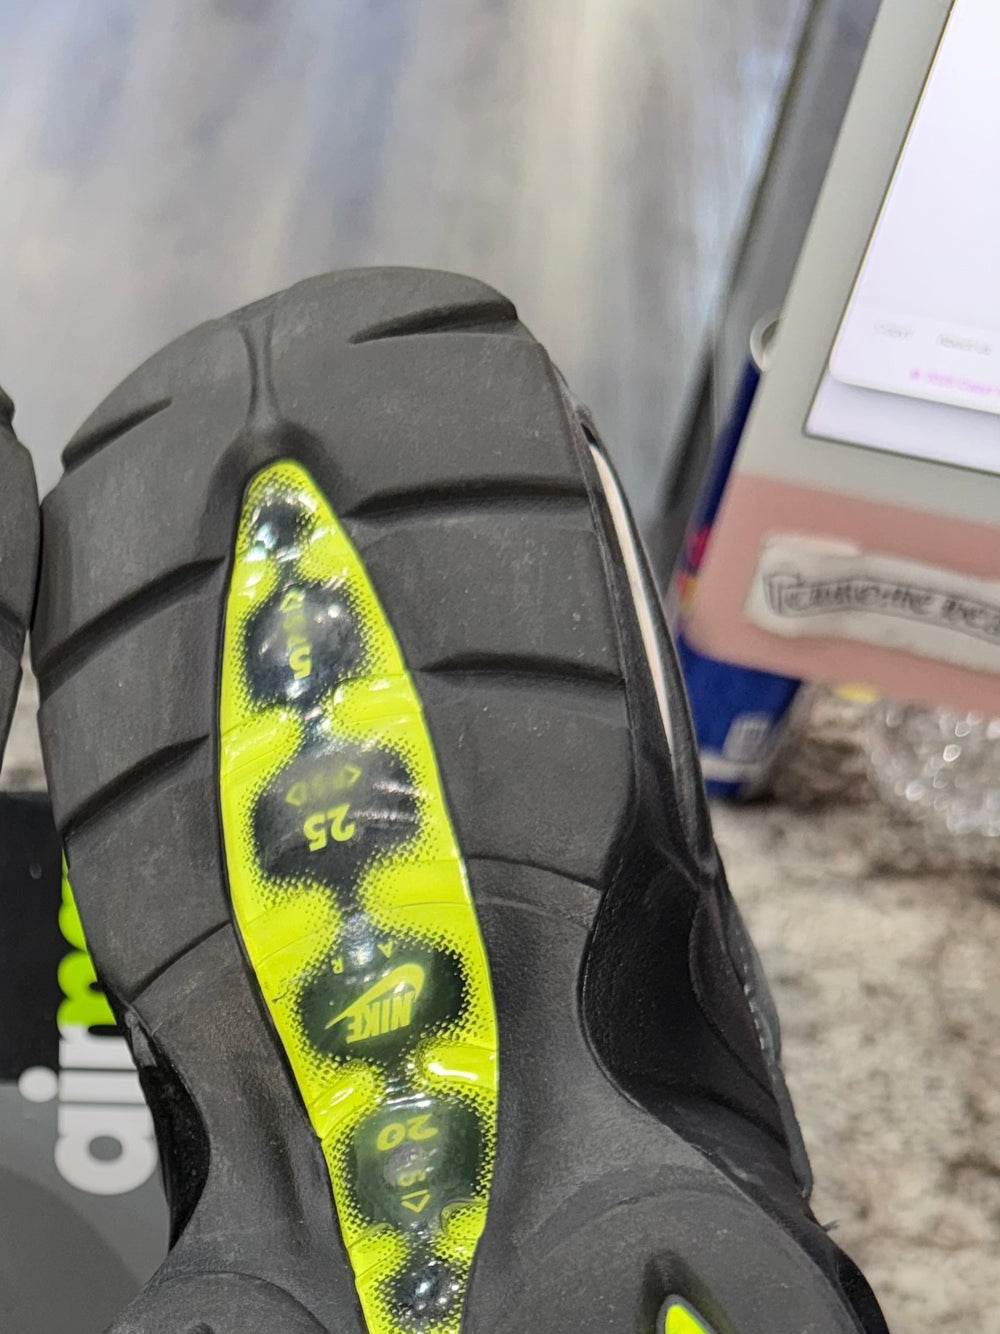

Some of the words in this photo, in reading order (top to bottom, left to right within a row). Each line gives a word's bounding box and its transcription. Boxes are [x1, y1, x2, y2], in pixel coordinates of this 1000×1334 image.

[289, 646, 311, 681] 5
[303, 803, 355, 852] 25
[18, 848, 158, 1195] airm
[345, 991, 415, 1044] NIKE
[376, 1113, 438, 1152] 20
